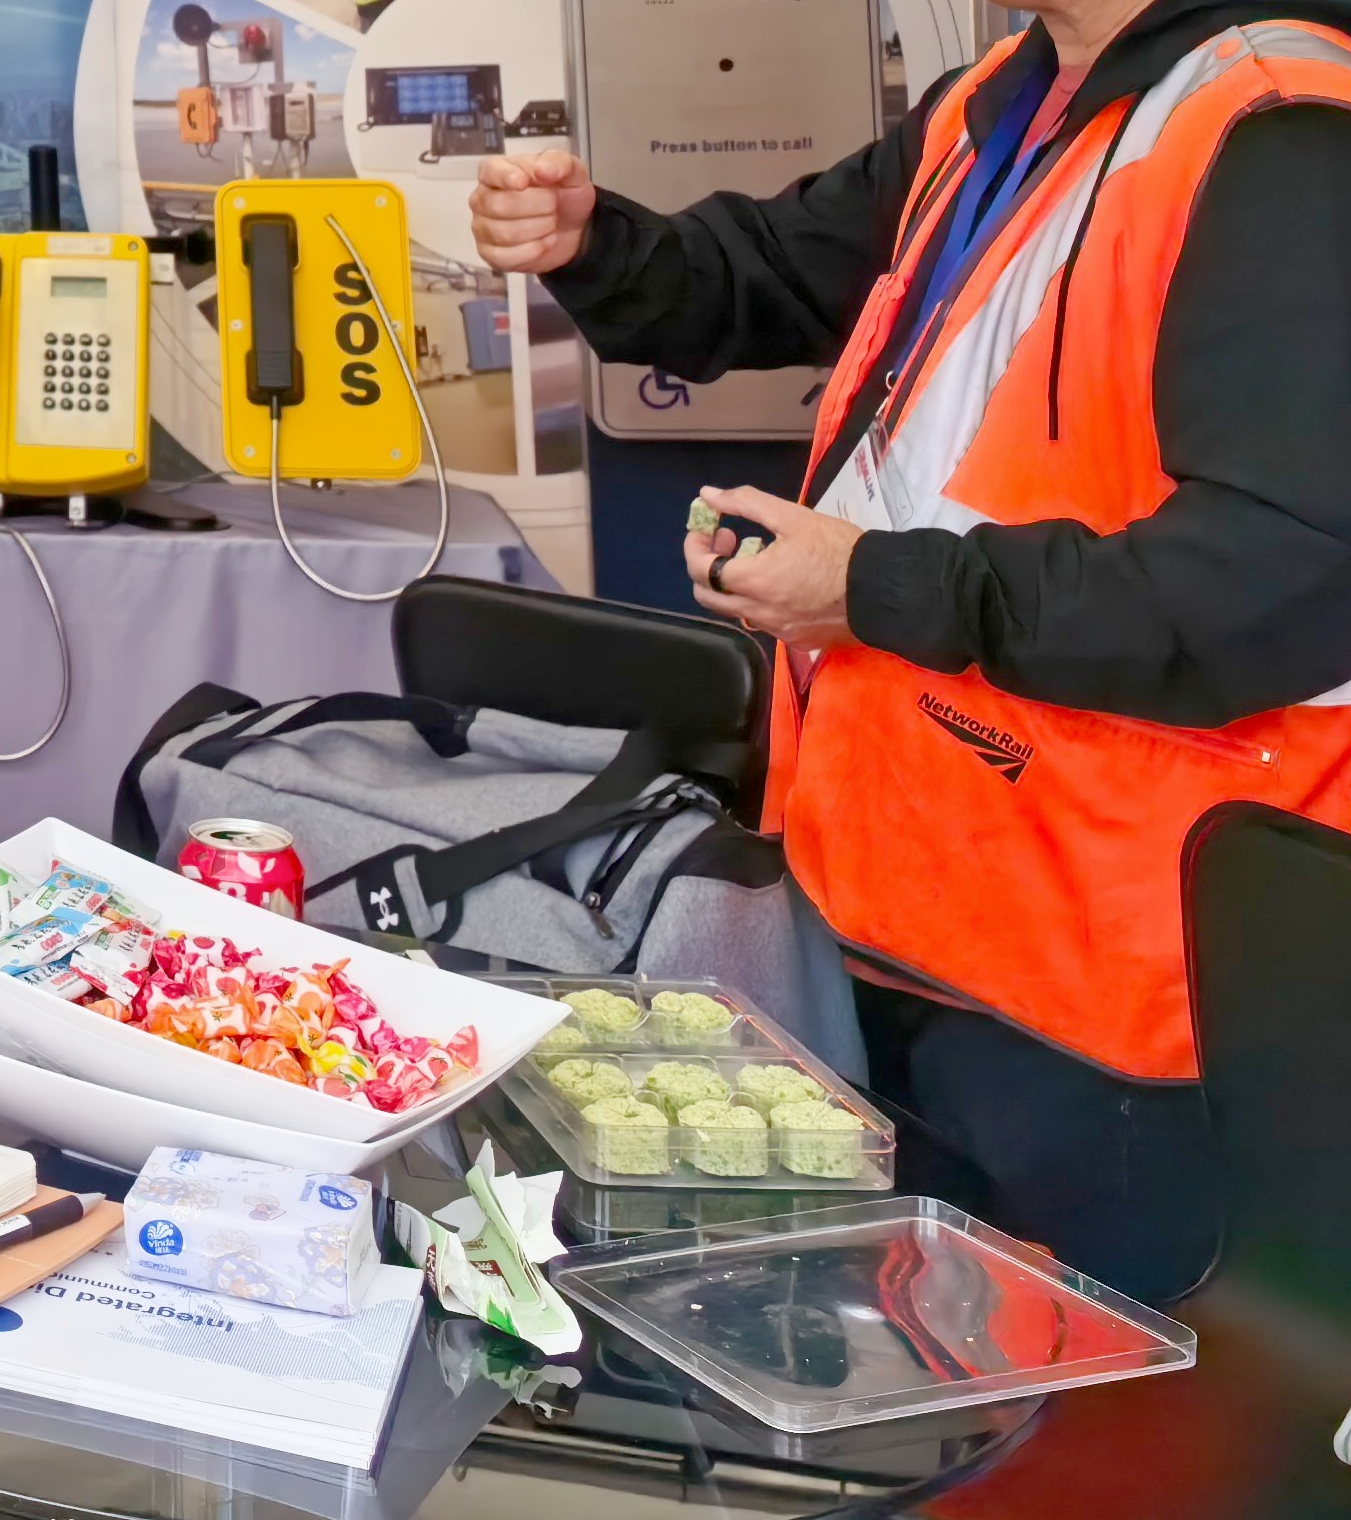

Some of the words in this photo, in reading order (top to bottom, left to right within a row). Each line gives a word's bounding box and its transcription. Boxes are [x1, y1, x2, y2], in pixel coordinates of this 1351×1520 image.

[650, 139, 698, 154] Press
[701, 138, 758, 153] button
[761, 138, 778, 151] to
[782, 136, 813, 151] call
[331, 262, 382, 406] SOS
[917, 691, 1034, 761] NetworkRail
[75, 1290, 234, 1333] Integrated
